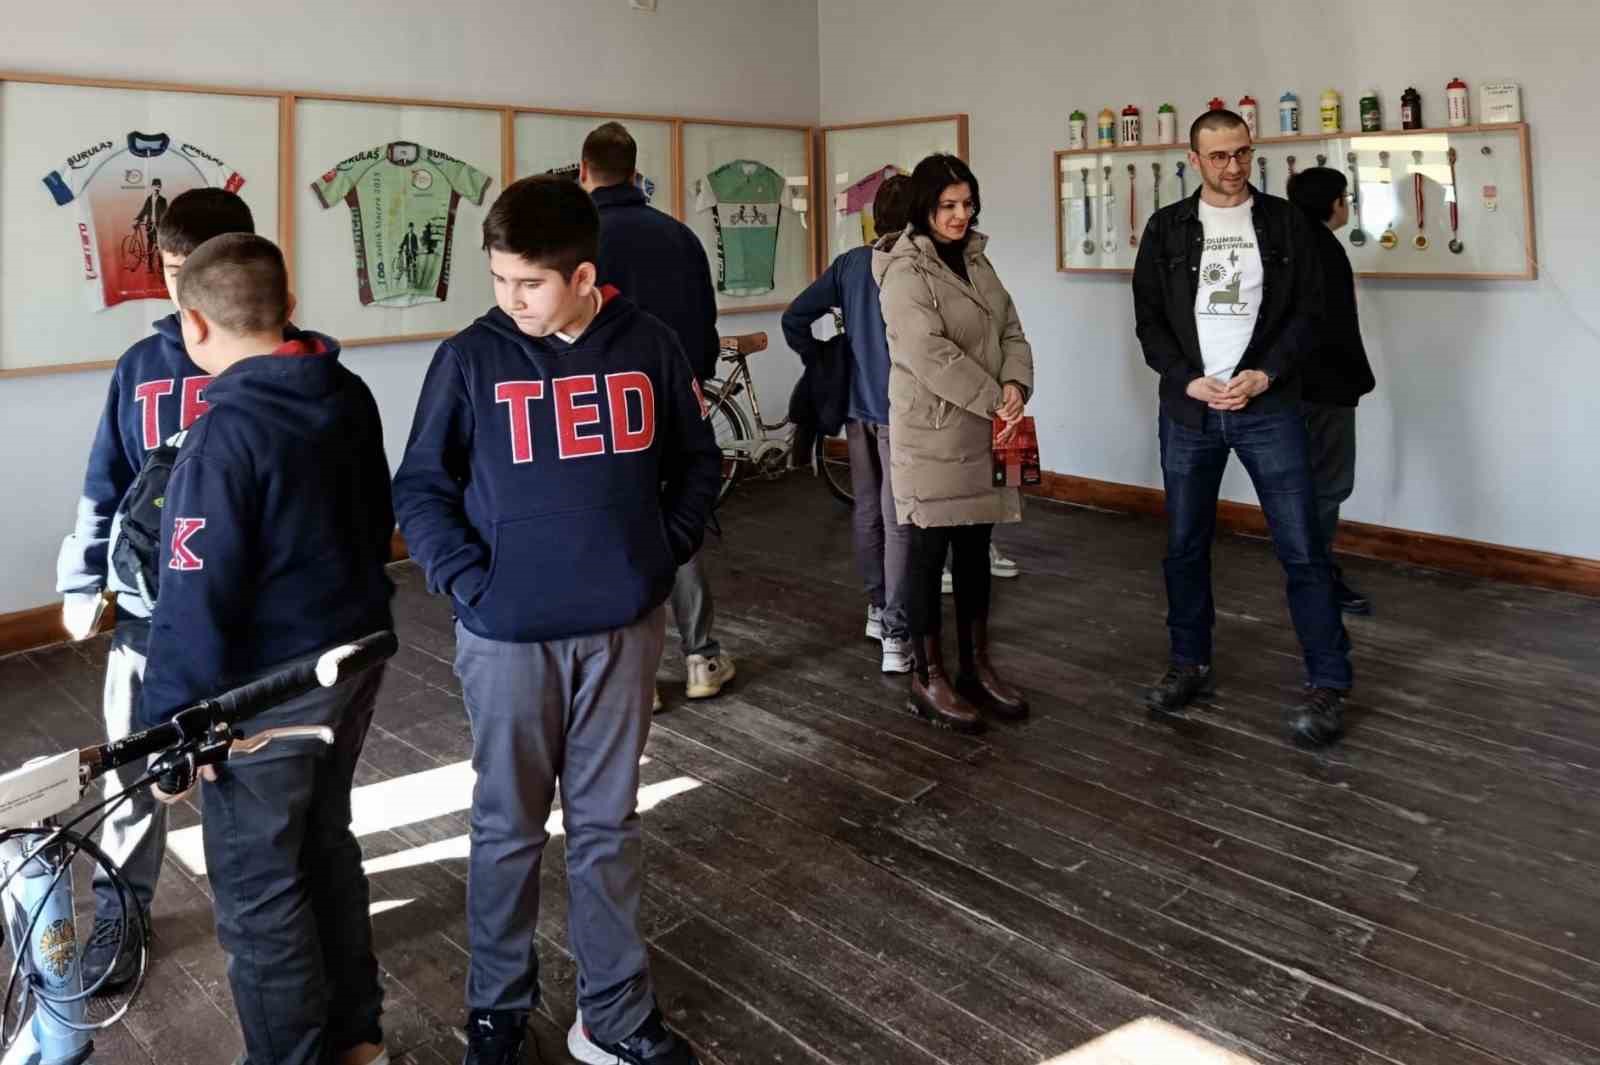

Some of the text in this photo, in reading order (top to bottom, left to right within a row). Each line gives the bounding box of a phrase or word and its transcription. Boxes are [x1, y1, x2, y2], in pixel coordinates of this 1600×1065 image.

[134, 374, 216, 451] TE
[495, 371, 655, 464] TED
[168, 517, 206, 571] K
